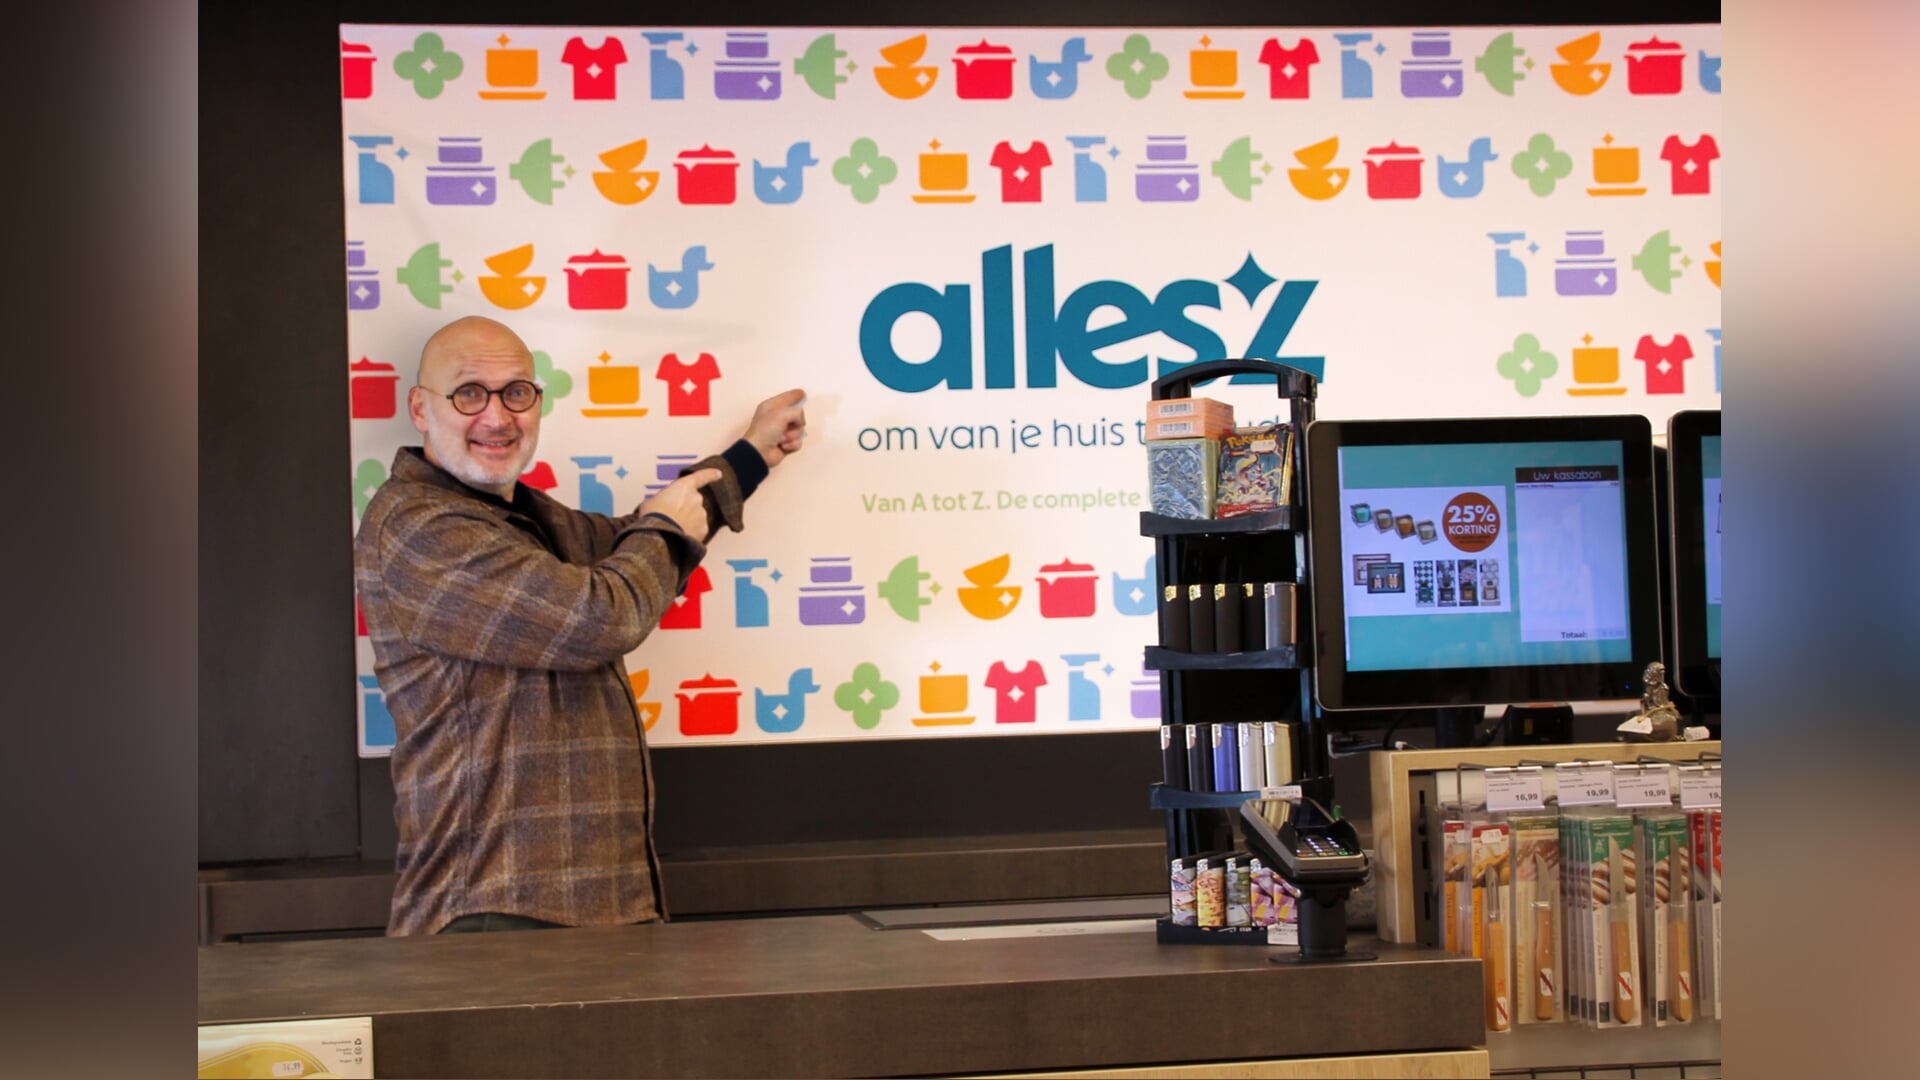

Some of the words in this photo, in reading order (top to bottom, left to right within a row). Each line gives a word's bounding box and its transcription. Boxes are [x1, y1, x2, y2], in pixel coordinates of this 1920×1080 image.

[859, 243, 1326, 393] allesz
[858, 426, 918, 452] om
[928, 425, 999, 450] van
[1010, 418, 1042, 454] je
[1053, 418, 1125, 447] huis
[1553, 470, 1602, 481] kassabon
[861, 492, 907, 514] Van
[910, 492, 928, 513] A
[931, 492, 967, 512] tot
[971, 491, 992, 511] Z.
[996, 491, 1028, 511] De
[1032, 487, 1141, 512] complete
[1448, 505, 1497, 523] 25%
[1448, 524, 1497, 535] KORTING
[1515, 793, 1538, 801] 16,99
[1586, 789, 1609, 798] 19,99
[1644, 789, 1666, 798] 19,99
